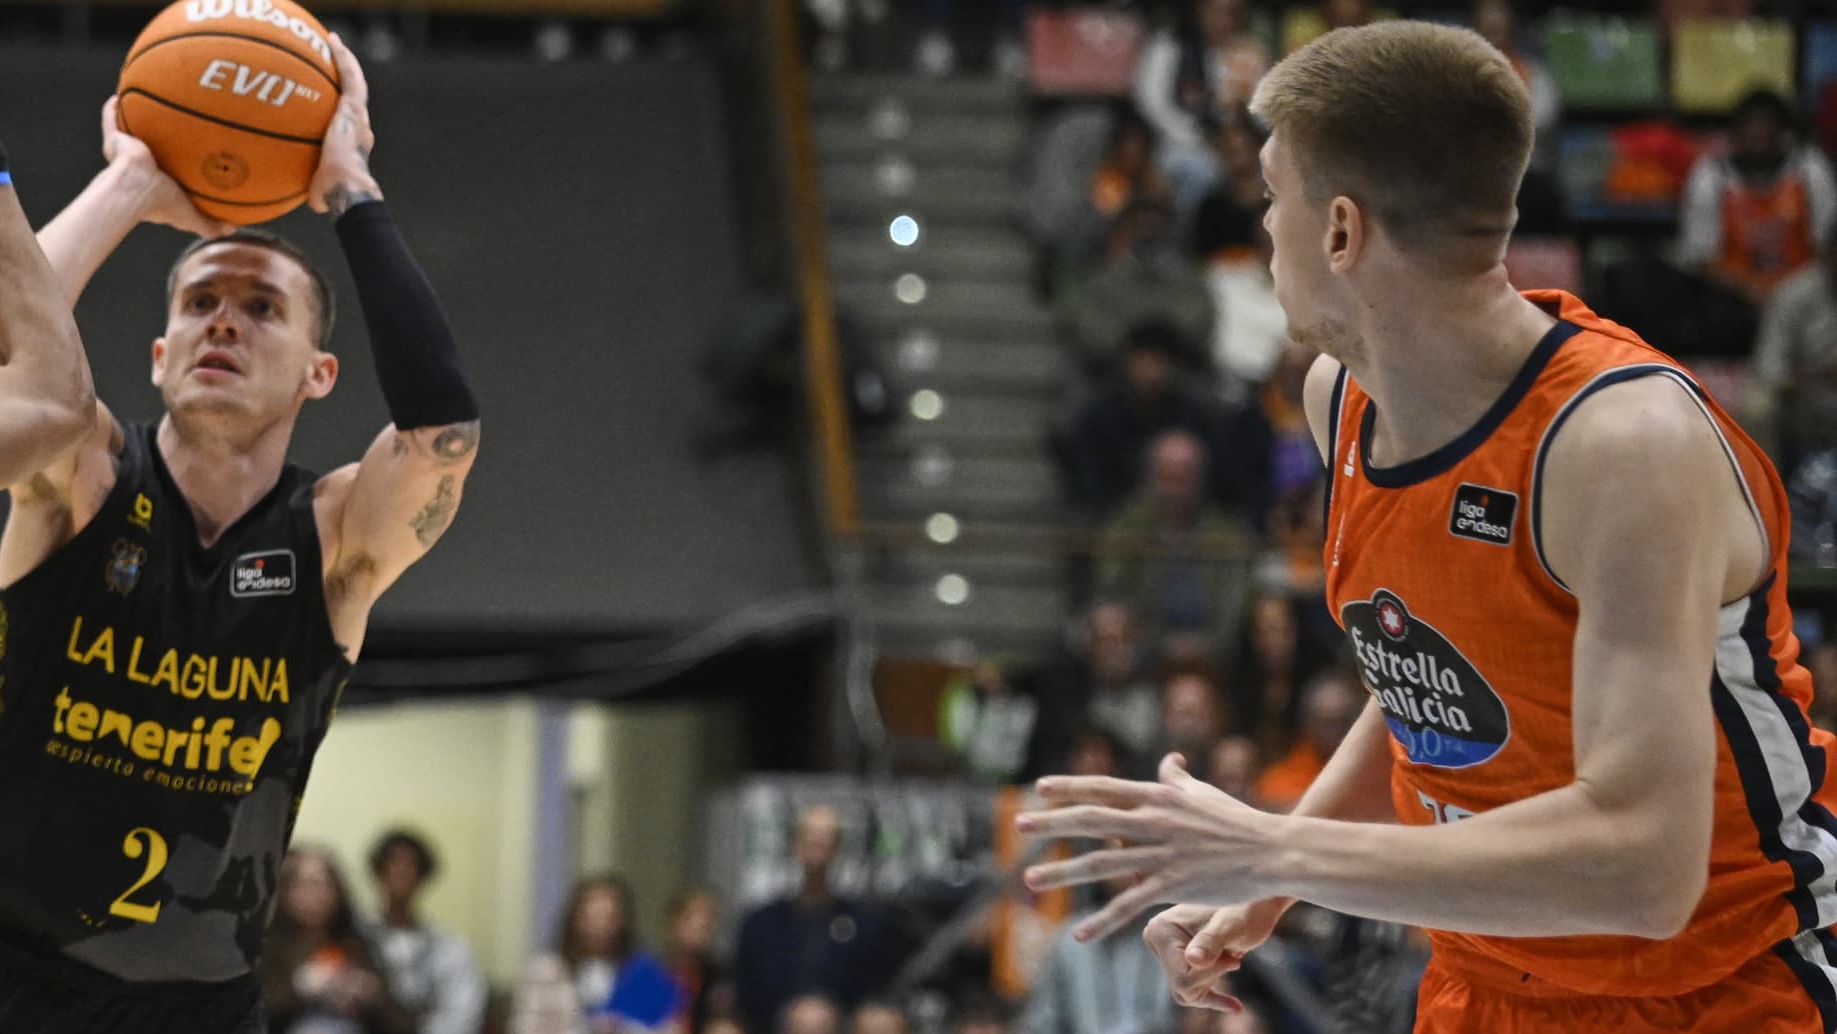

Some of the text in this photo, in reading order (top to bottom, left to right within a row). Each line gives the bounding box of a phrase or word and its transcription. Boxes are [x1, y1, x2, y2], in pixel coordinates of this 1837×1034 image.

[1456, 517, 1508, 539] endesa
[1459, 500, 1486, 519] liga
[67, 615, 290, 704] LA LAGUNA
[1351, 625, 1464, 697] Estrella
[109, 827, 168, 923] 2
